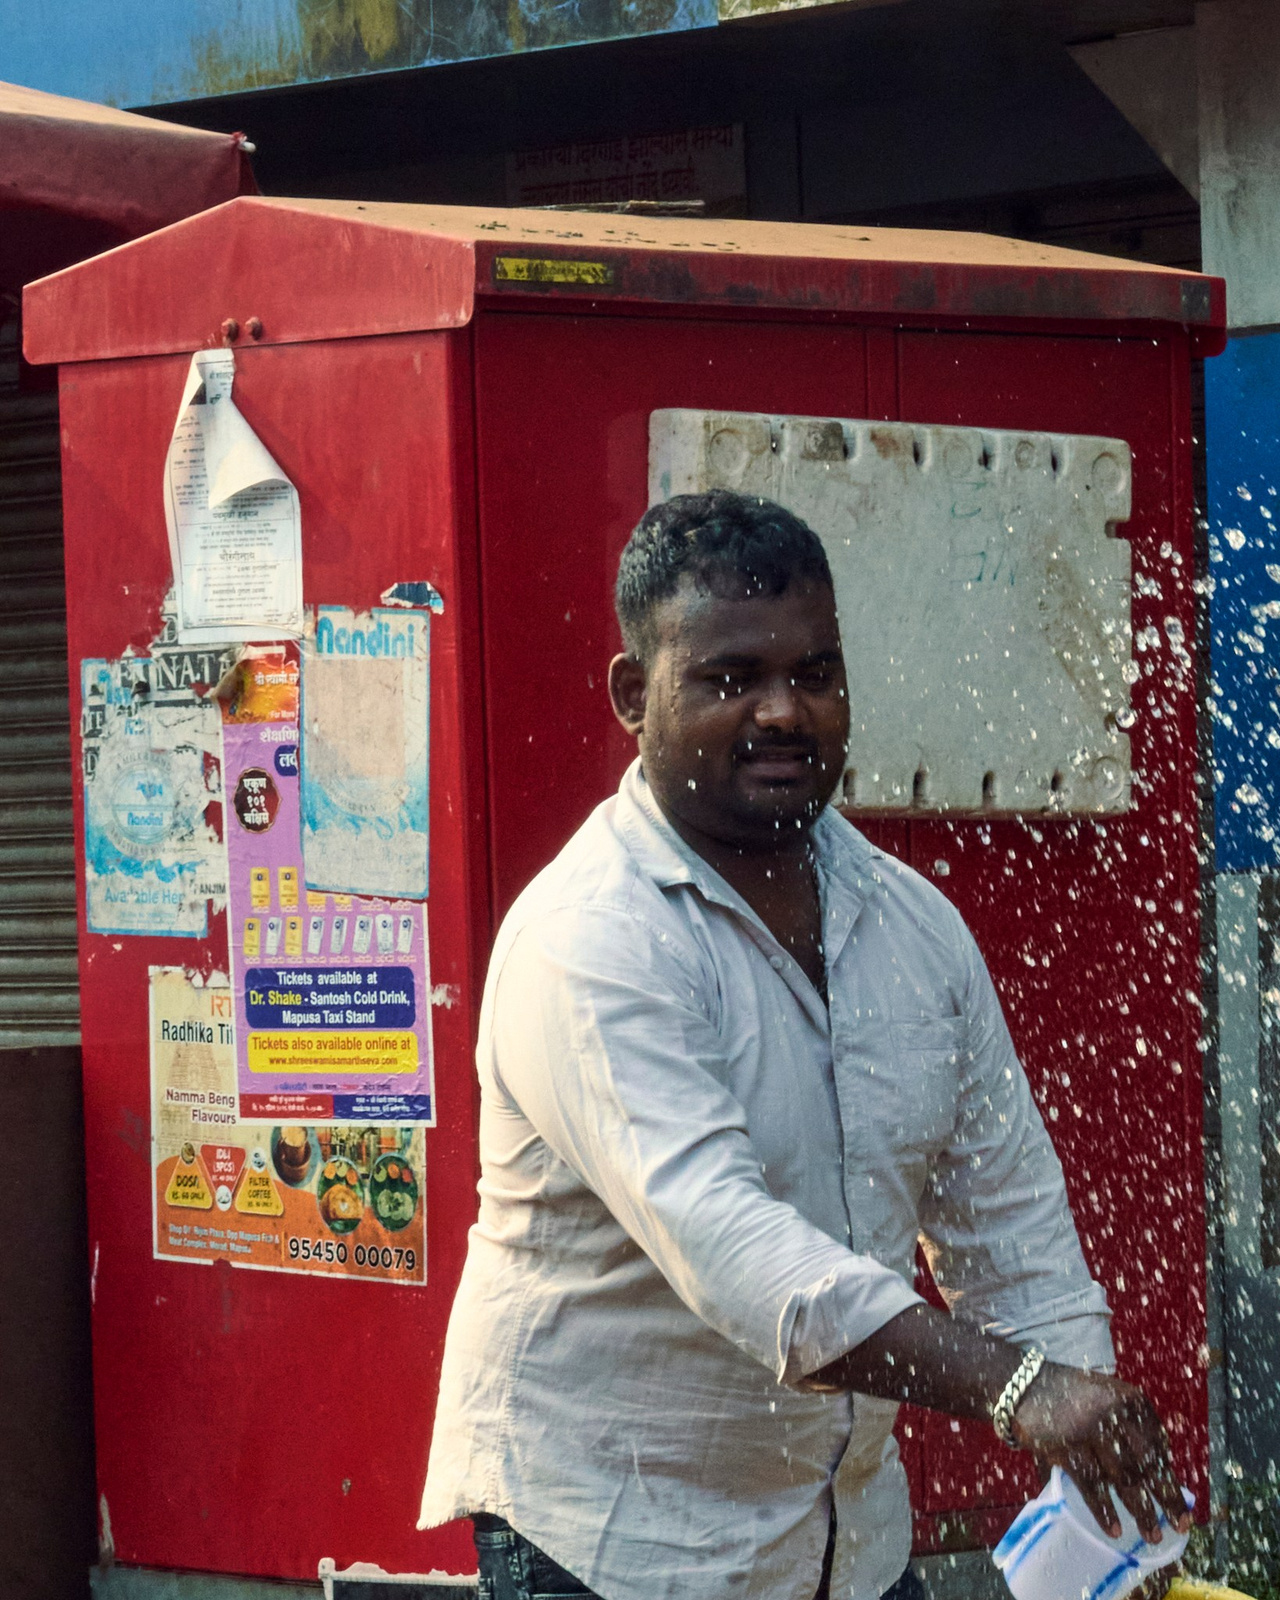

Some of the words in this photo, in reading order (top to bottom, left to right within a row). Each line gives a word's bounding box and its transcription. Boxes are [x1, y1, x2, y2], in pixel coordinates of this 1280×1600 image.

[316, 616, 415, 658] Nandini
[243, 777, 267, 794] एकूण
[246, 794, 266, 808] १०१
[127, 812, 163, 826] Nandini
[243, 808, 269, 825] बक्षिसे
[277, 971, 313, 985] Tickets
[317, 971, 362, 985] available
[366, 971, 378, 984] at
[250, 990, 265, 1005] Dr.
[268, 990, 302, 1005] Shake
[310, 990, 352, 1005] Santosh
[353, 990, 377, 1005] Cold
[379, 990, 410, 1007] Drink,
[282, 1010, 321, 1026] Mapusa
[322, 1010, 344, 1024] Taxi
[345, 1010, 376, 1024] Stand
[161, 1019, 214, 1044] Radhika
[252, 1036, 289, 1051] Tickets
[291, 1036, 313, 1051] also
[316, 1036, 362, 1051] available
[365, 1036, 397, 1051] online
[400, 1037, 410, 1050] at
[166, 1088, 206, 1104] Namma
[208, 1092, 235, 1108] Beng
[191, 1109, 237, 1125] Flavours
[176, 1174, 200, 1188] DOSA
[249, 1177, 270, 1188] FILTER
[239, 1231, 261, 1242] Mapusa
[288, 1237, 348, 1265] 95450
[354, 1244, 417, 1272] 00079
